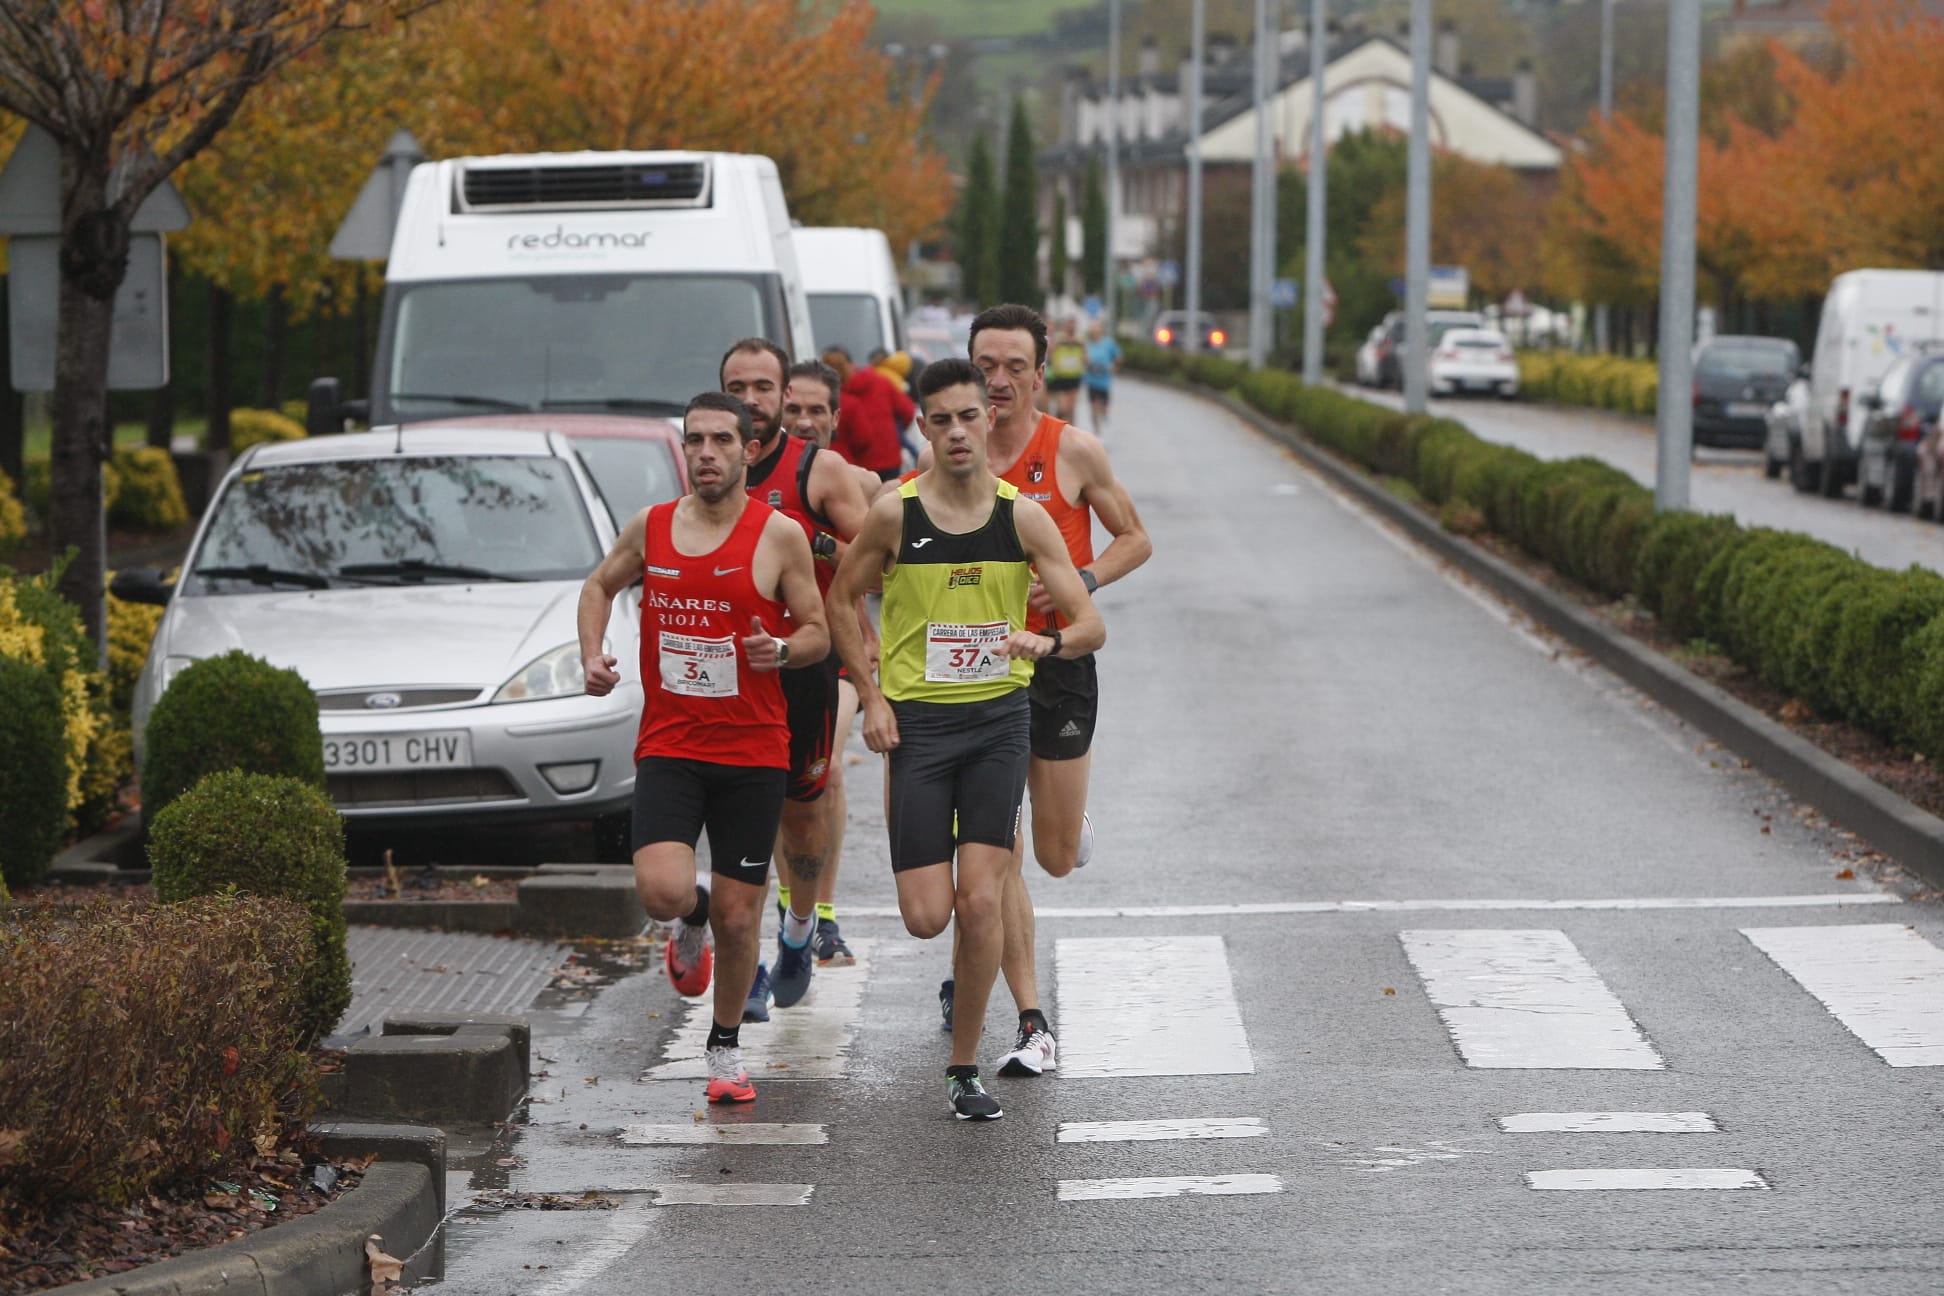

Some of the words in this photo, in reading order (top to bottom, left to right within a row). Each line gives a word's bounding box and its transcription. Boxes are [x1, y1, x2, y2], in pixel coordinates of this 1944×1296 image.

[507, 223, 653, 249] redamar
[658, 613, 711, 627] RIOJA
[932, 628, 958, 638] CARRERA
[958, 628, 966, 638] DE
[967, 629, 979, 638] LAS
[324, 739, 390, 766] 3301
[406, 737, 458, 762] CHV
